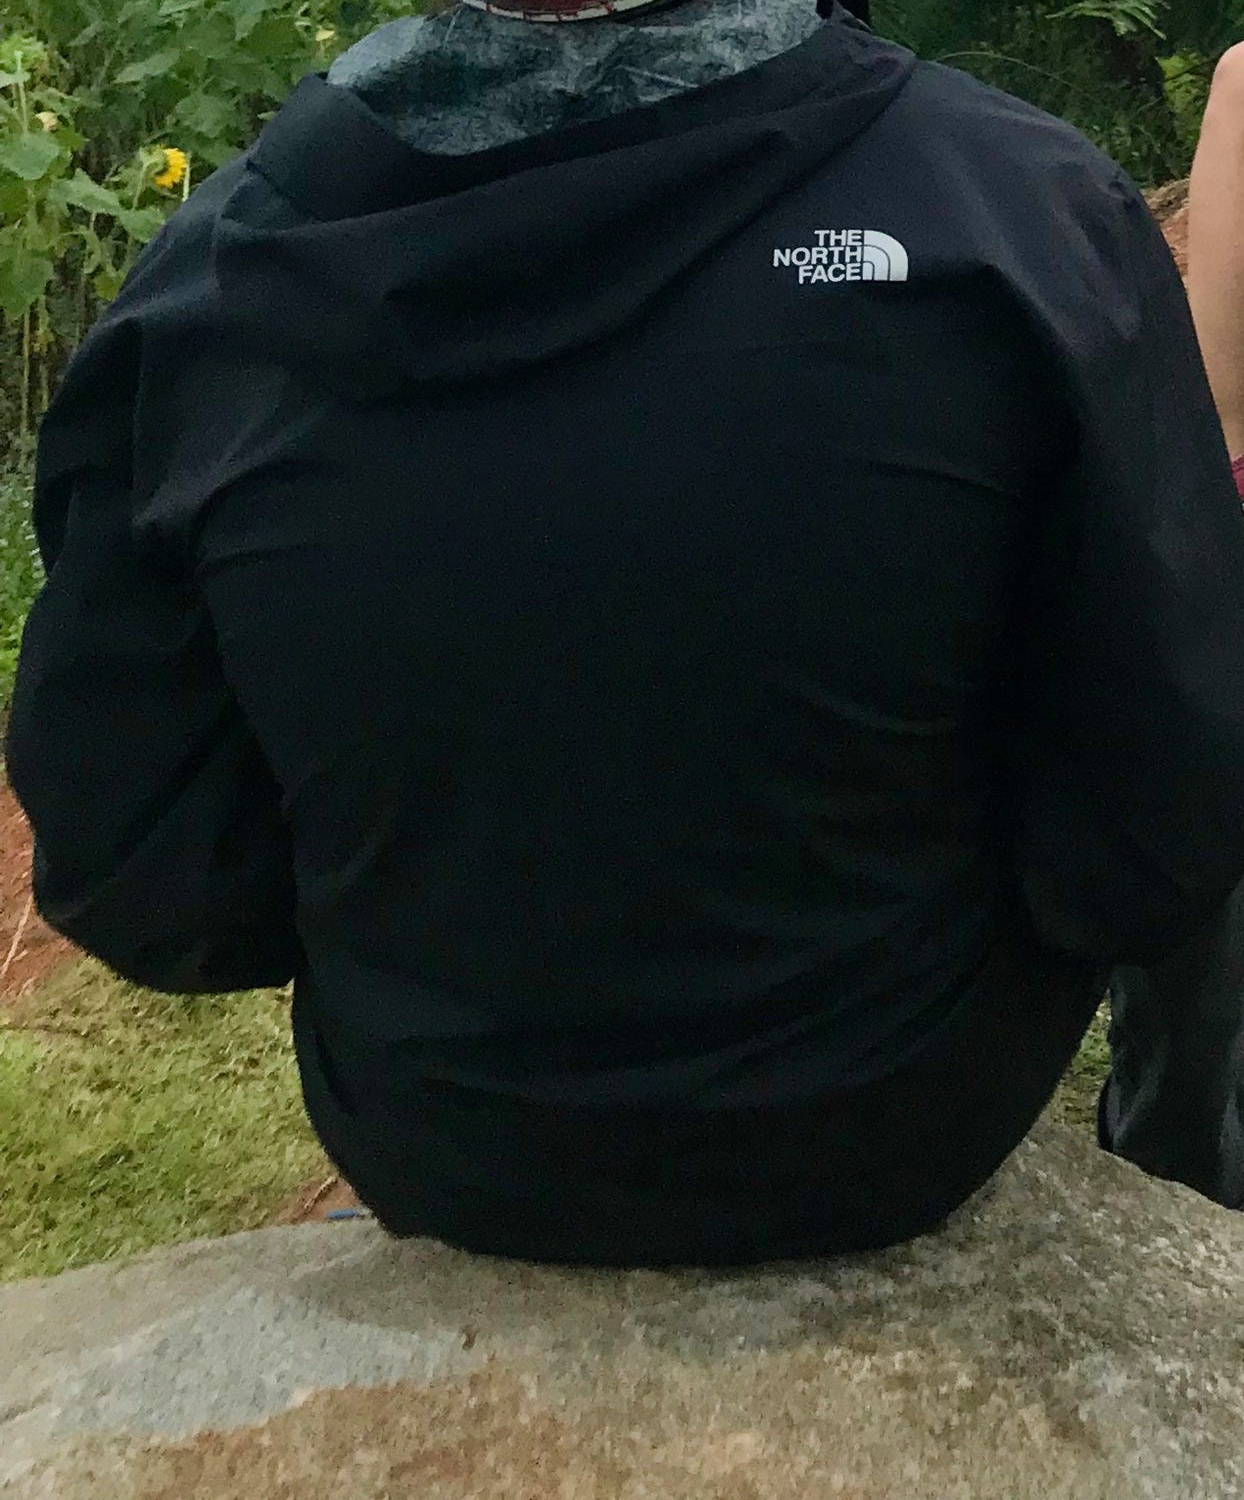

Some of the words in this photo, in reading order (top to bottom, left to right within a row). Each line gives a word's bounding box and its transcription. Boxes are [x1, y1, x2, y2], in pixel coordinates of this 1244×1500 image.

[813, 229, 862, 247] THE
[773, 246, 862, 267] NORTH
[798, 263, 861, 284] FACE
